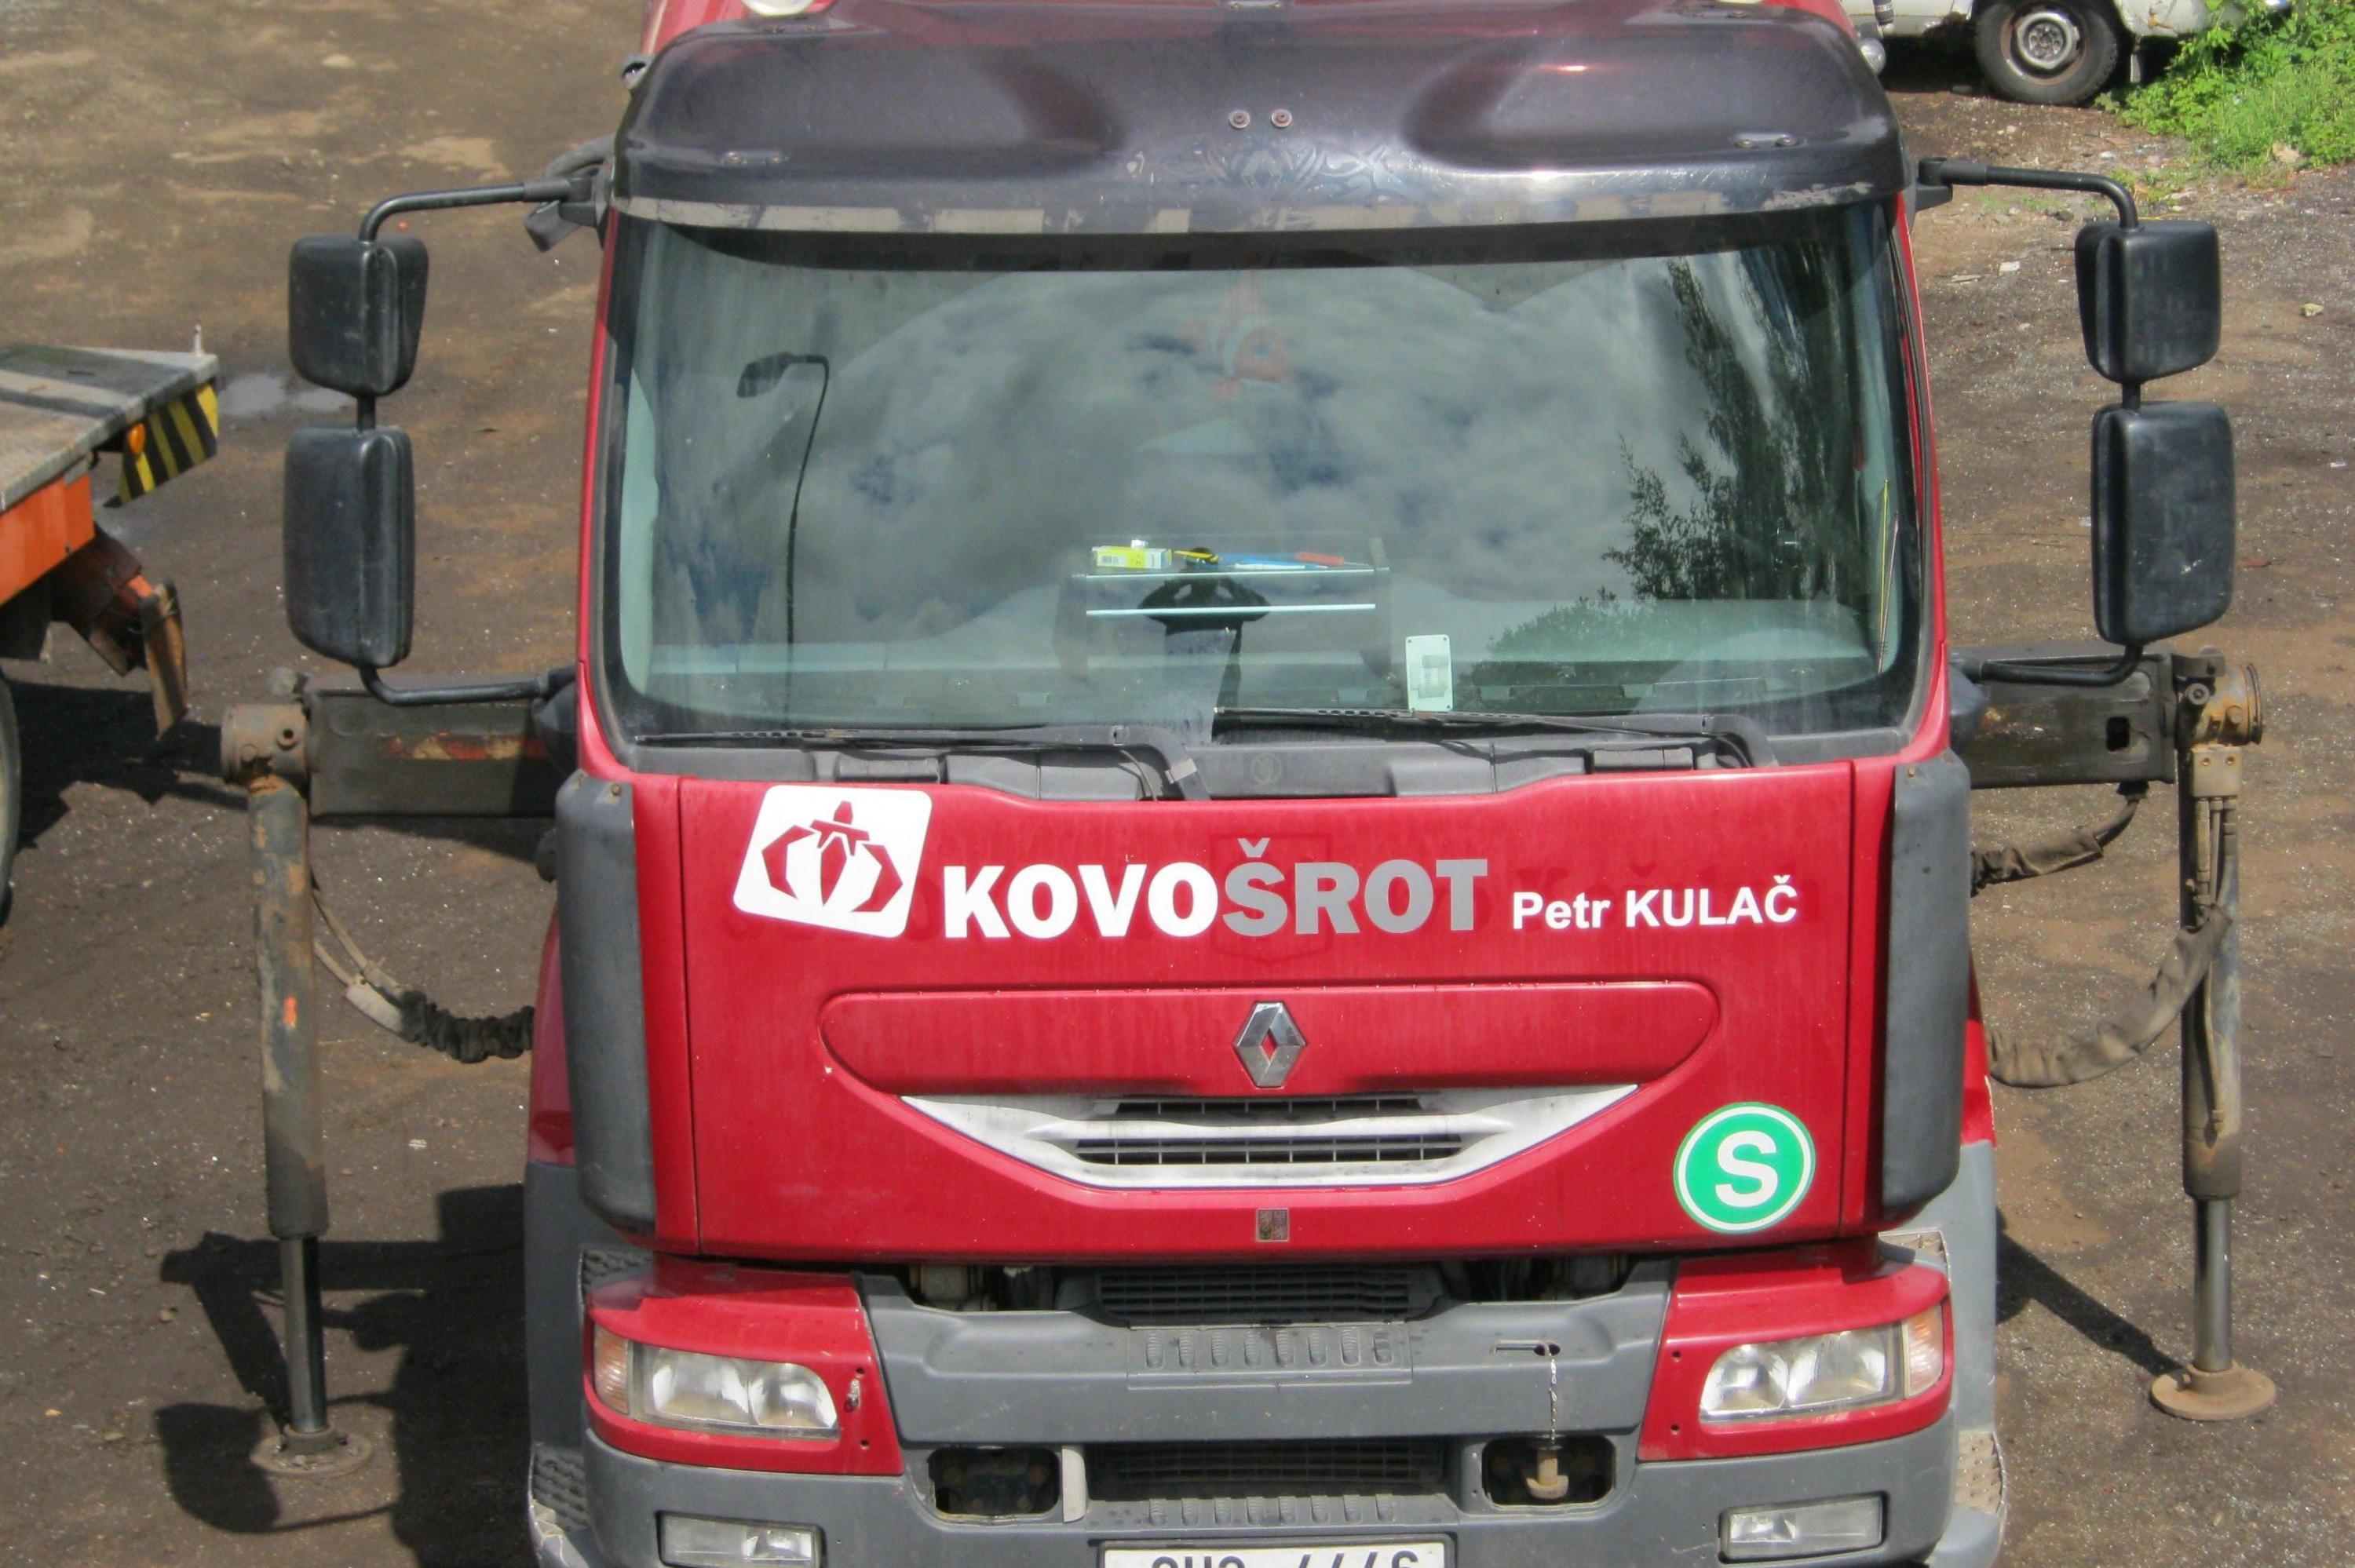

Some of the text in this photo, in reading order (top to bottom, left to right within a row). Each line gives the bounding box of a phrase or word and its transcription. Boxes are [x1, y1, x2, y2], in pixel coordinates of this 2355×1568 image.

[944, 837, 1798, 939] KOVOŠROT Petr KULAČ
[1715, 1130, 1779, 1208] S
